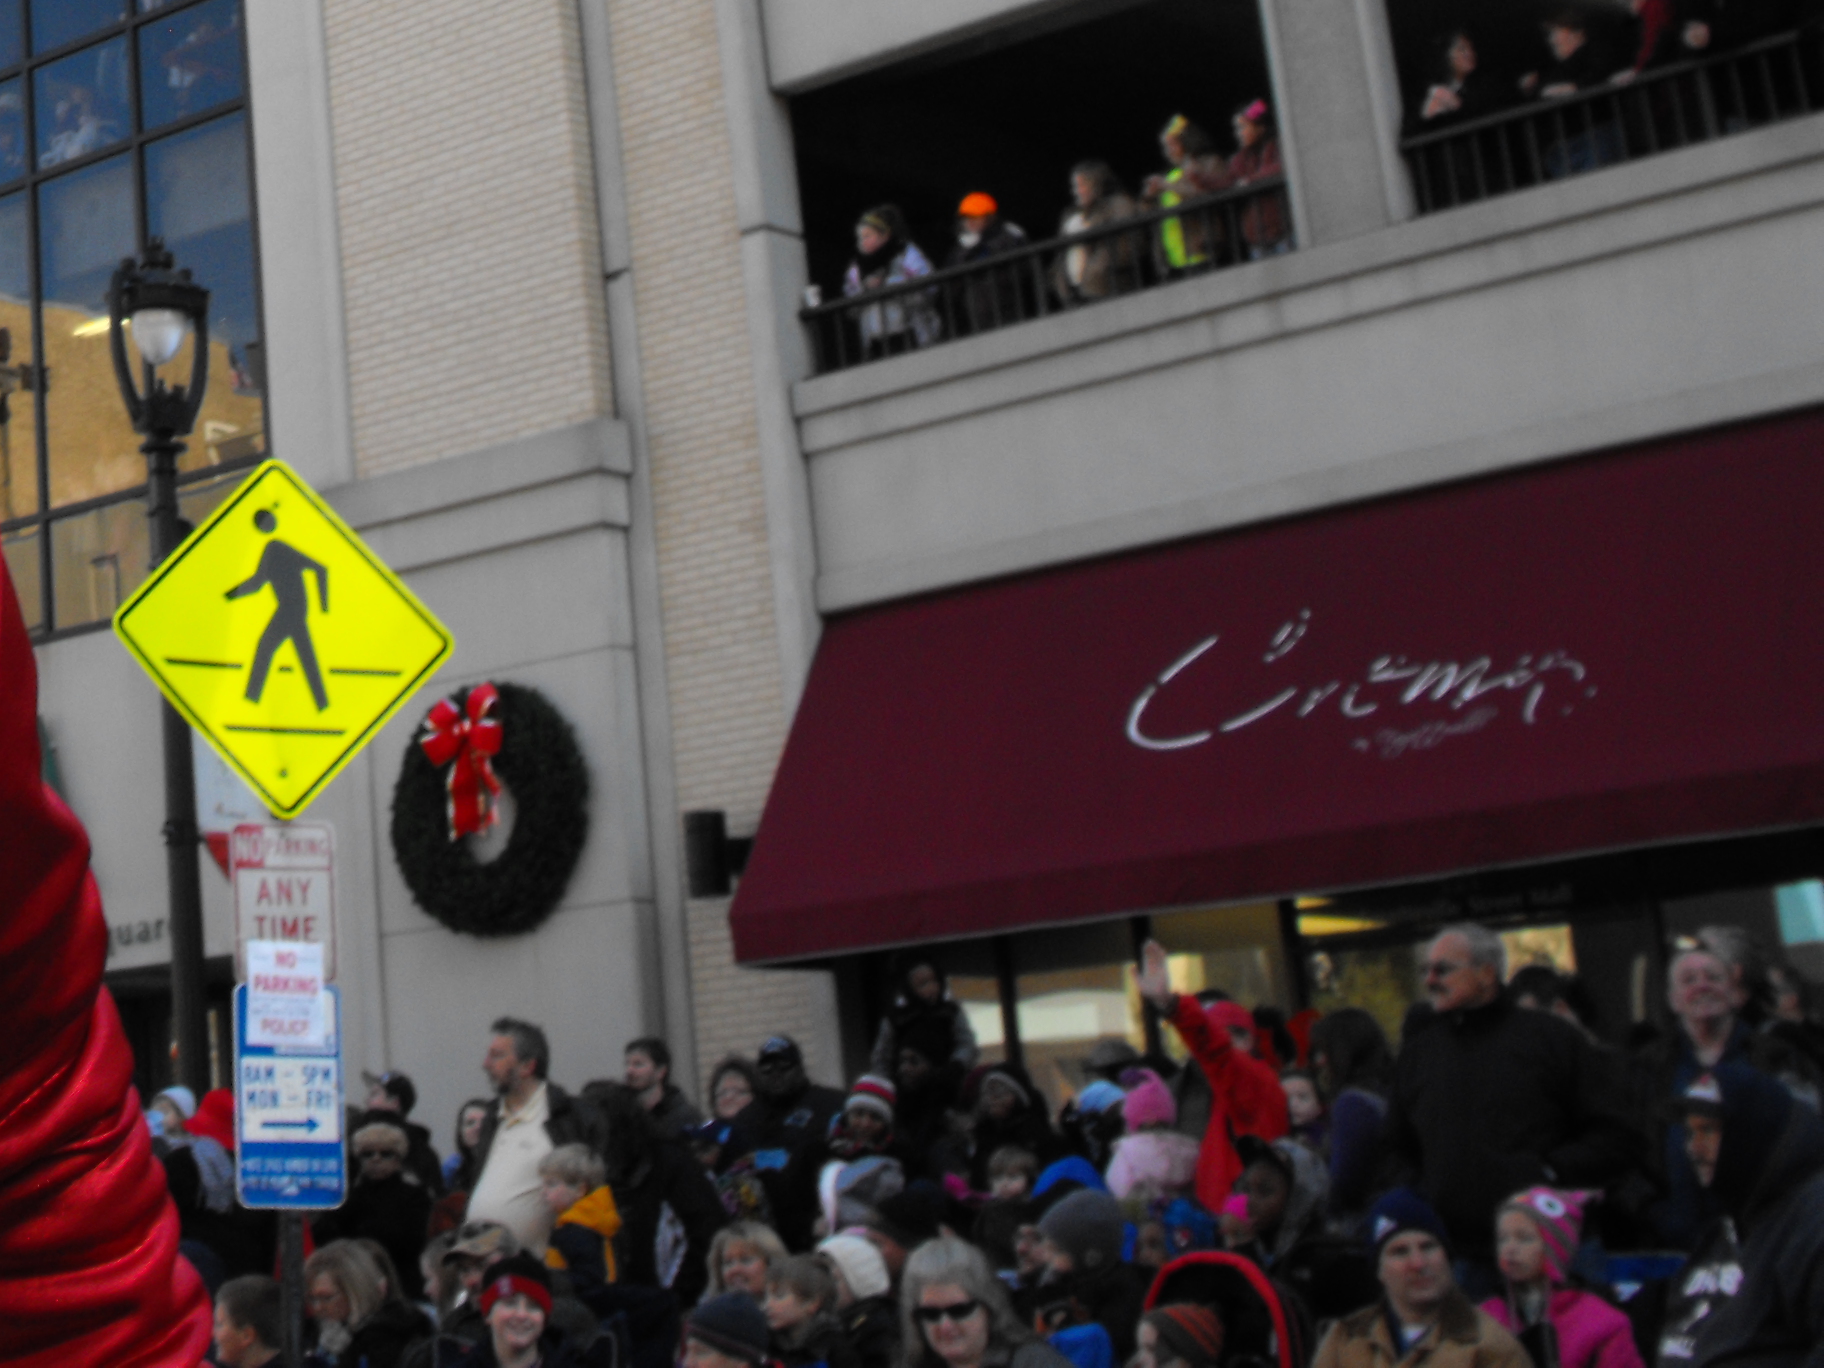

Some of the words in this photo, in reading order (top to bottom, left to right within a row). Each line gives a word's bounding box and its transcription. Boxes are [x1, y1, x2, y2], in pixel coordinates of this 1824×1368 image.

[235, 832, 264, 862] NO
[257, 877, 312, 906] ANY
[254, 914, 317, 941] TIME
[274, 951, 297, 969] NO
[253, 974, 319, 996] PARKING
[261, 1018, 309, 1036] POLICE
[247, 1089, 279, 1109] MON
[307, 1089, 332, 1110] FRI
